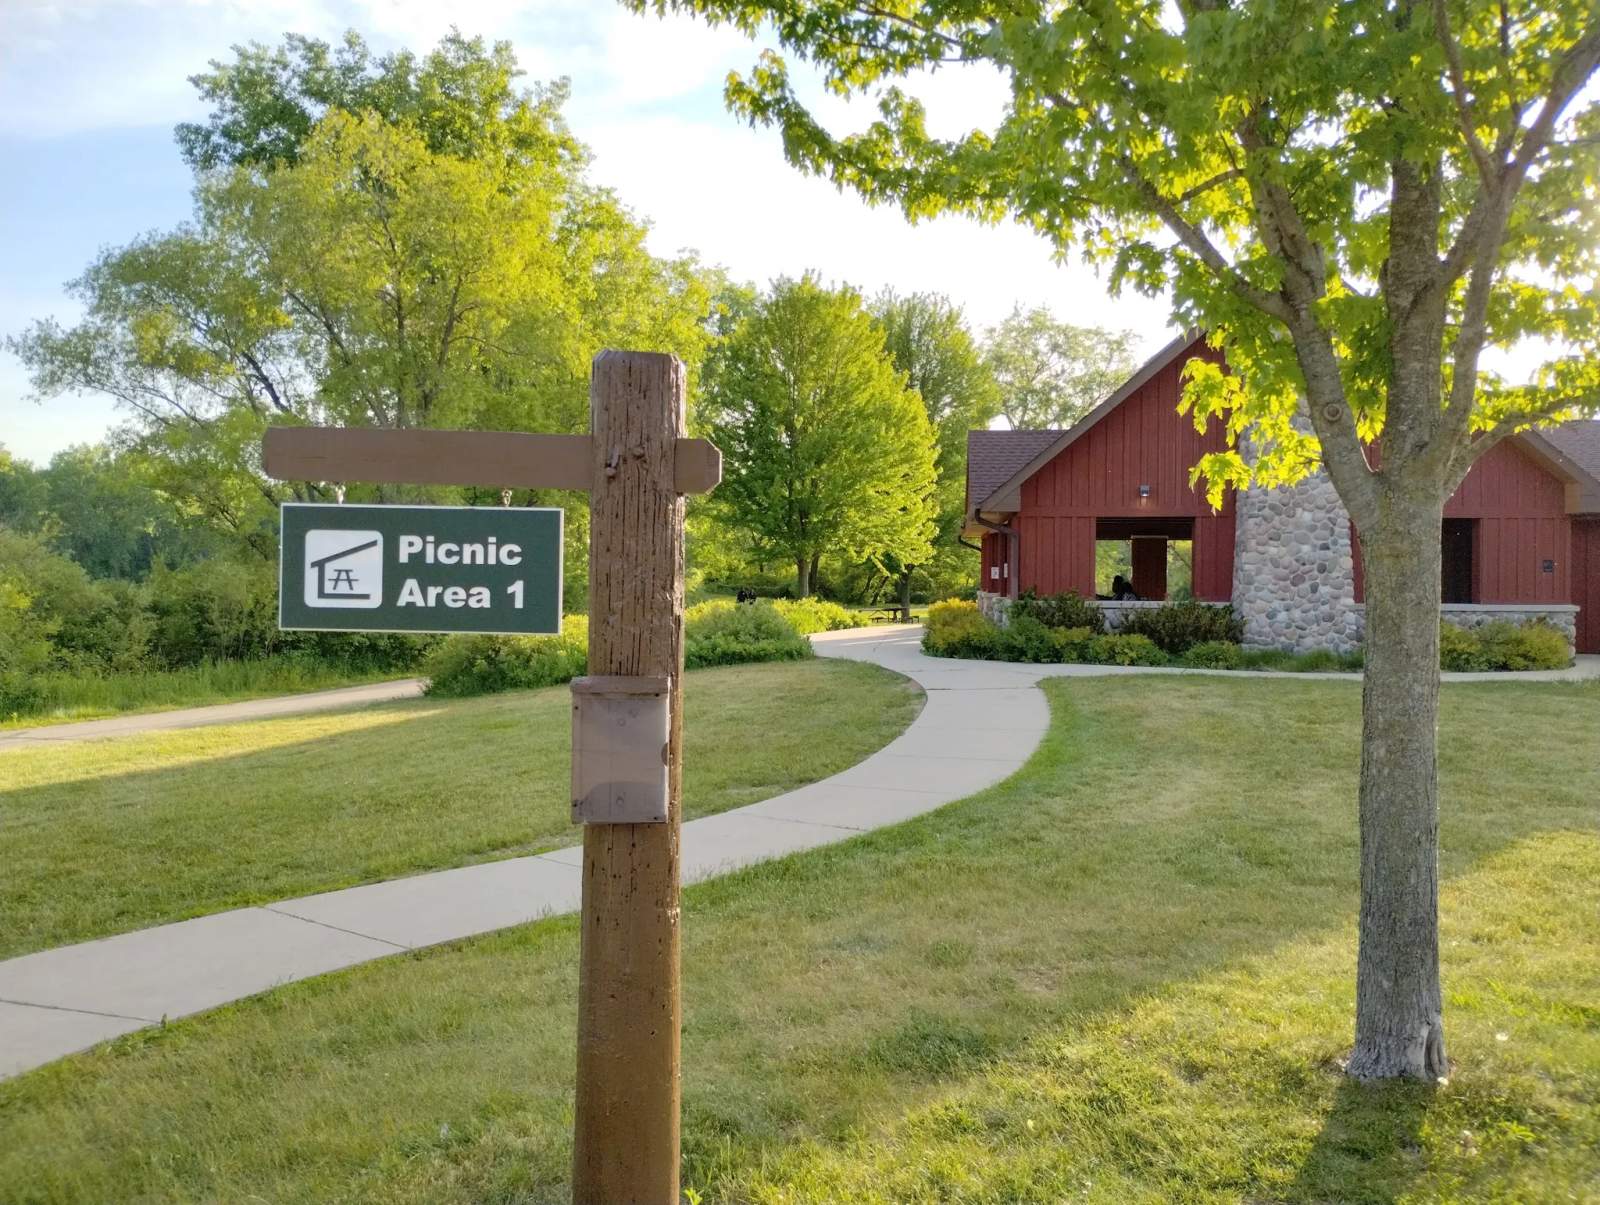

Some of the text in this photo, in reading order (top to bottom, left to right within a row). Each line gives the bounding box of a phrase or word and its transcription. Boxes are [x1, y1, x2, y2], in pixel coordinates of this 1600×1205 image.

[398, 534, 523, 566] Picnic
[396, 578, 524, 609] Area 1
